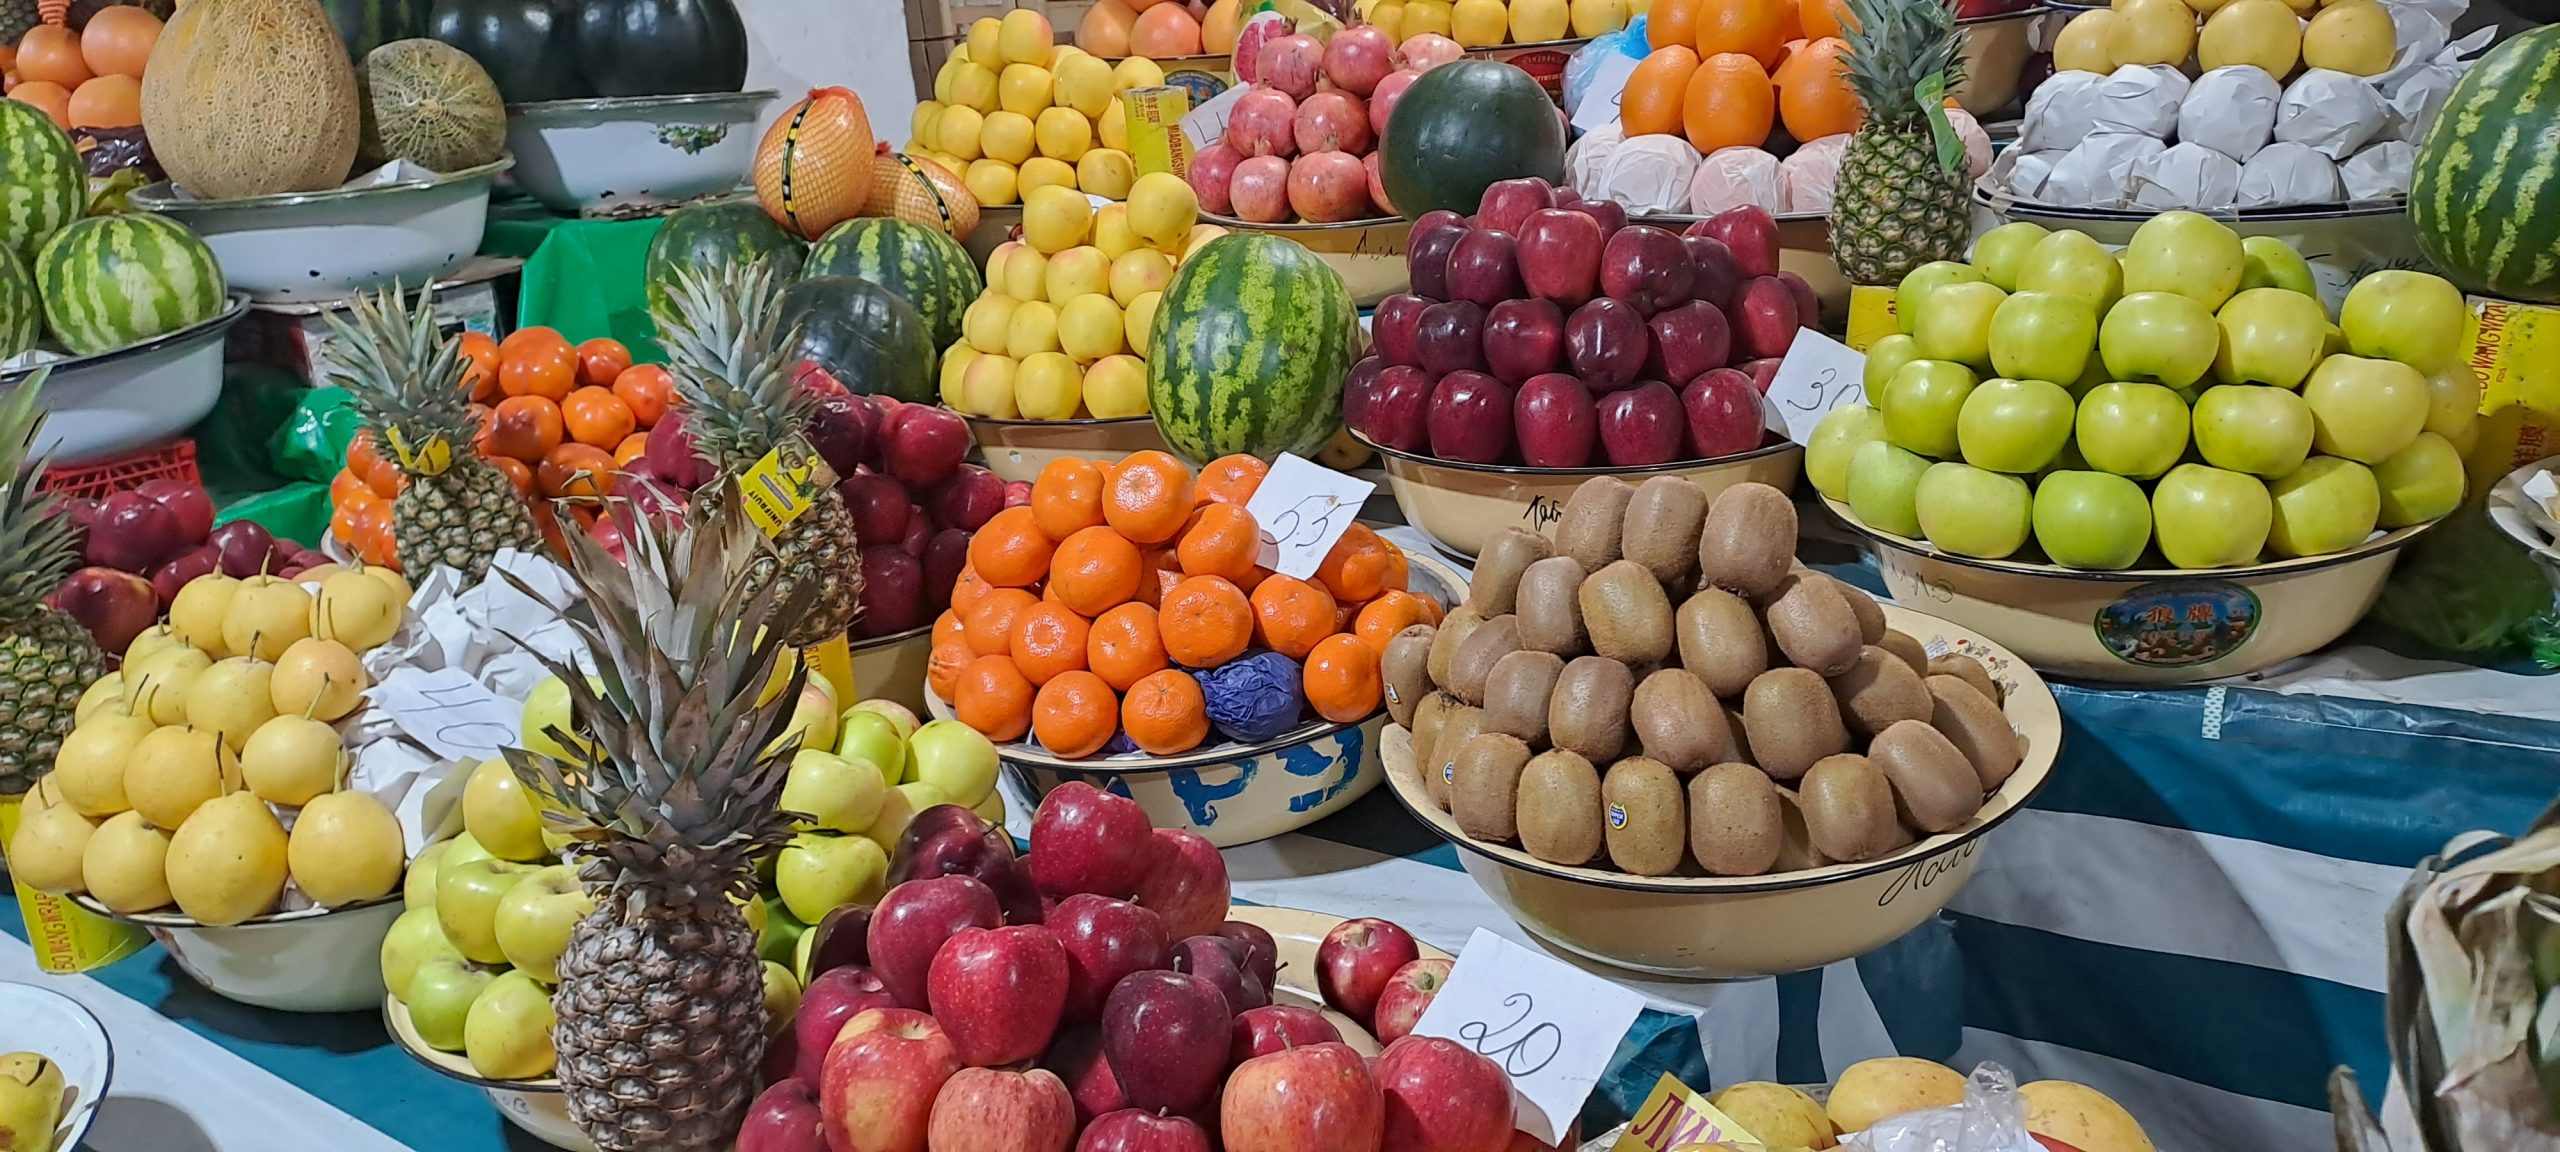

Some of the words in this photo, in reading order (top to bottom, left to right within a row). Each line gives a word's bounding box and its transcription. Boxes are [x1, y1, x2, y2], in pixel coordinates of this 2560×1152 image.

[748, 490, 782, 527] UNIFRUIT
[1459, 992, 1562, 1078] 20
[1631, 1092, 1722, 1152] ЛИ
